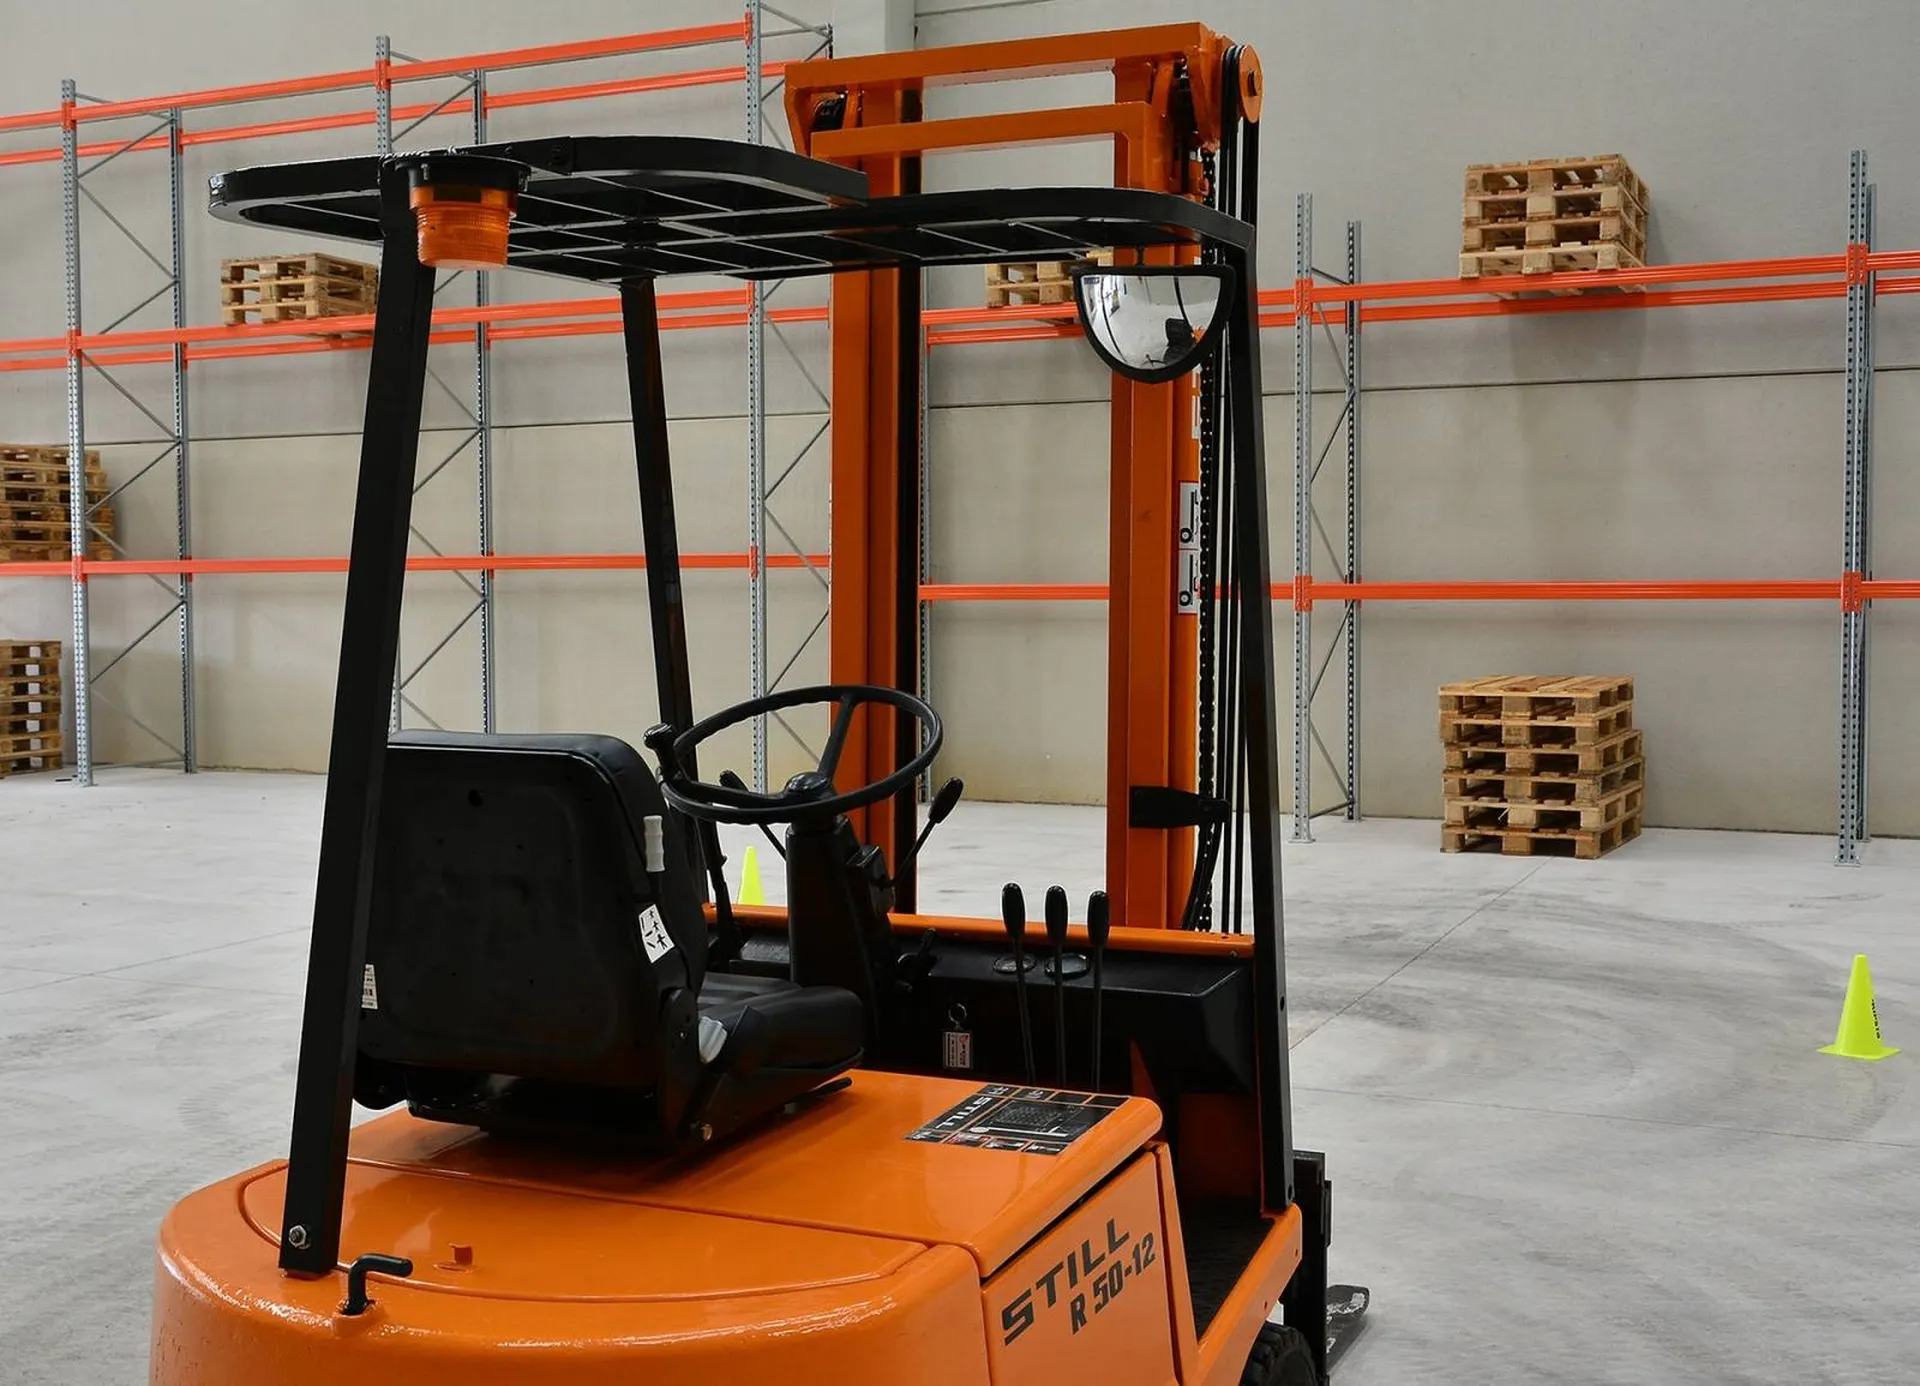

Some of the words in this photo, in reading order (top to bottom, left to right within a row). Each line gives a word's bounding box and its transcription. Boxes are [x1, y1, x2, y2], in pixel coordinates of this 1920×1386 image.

[935, 1096, 993, 1129] STILL
[1002, 1219, 1130, 1346] STILL
[1070, 1292, 1087, 1335] R
[1093, 1232, 1156, 1314] 50-12
